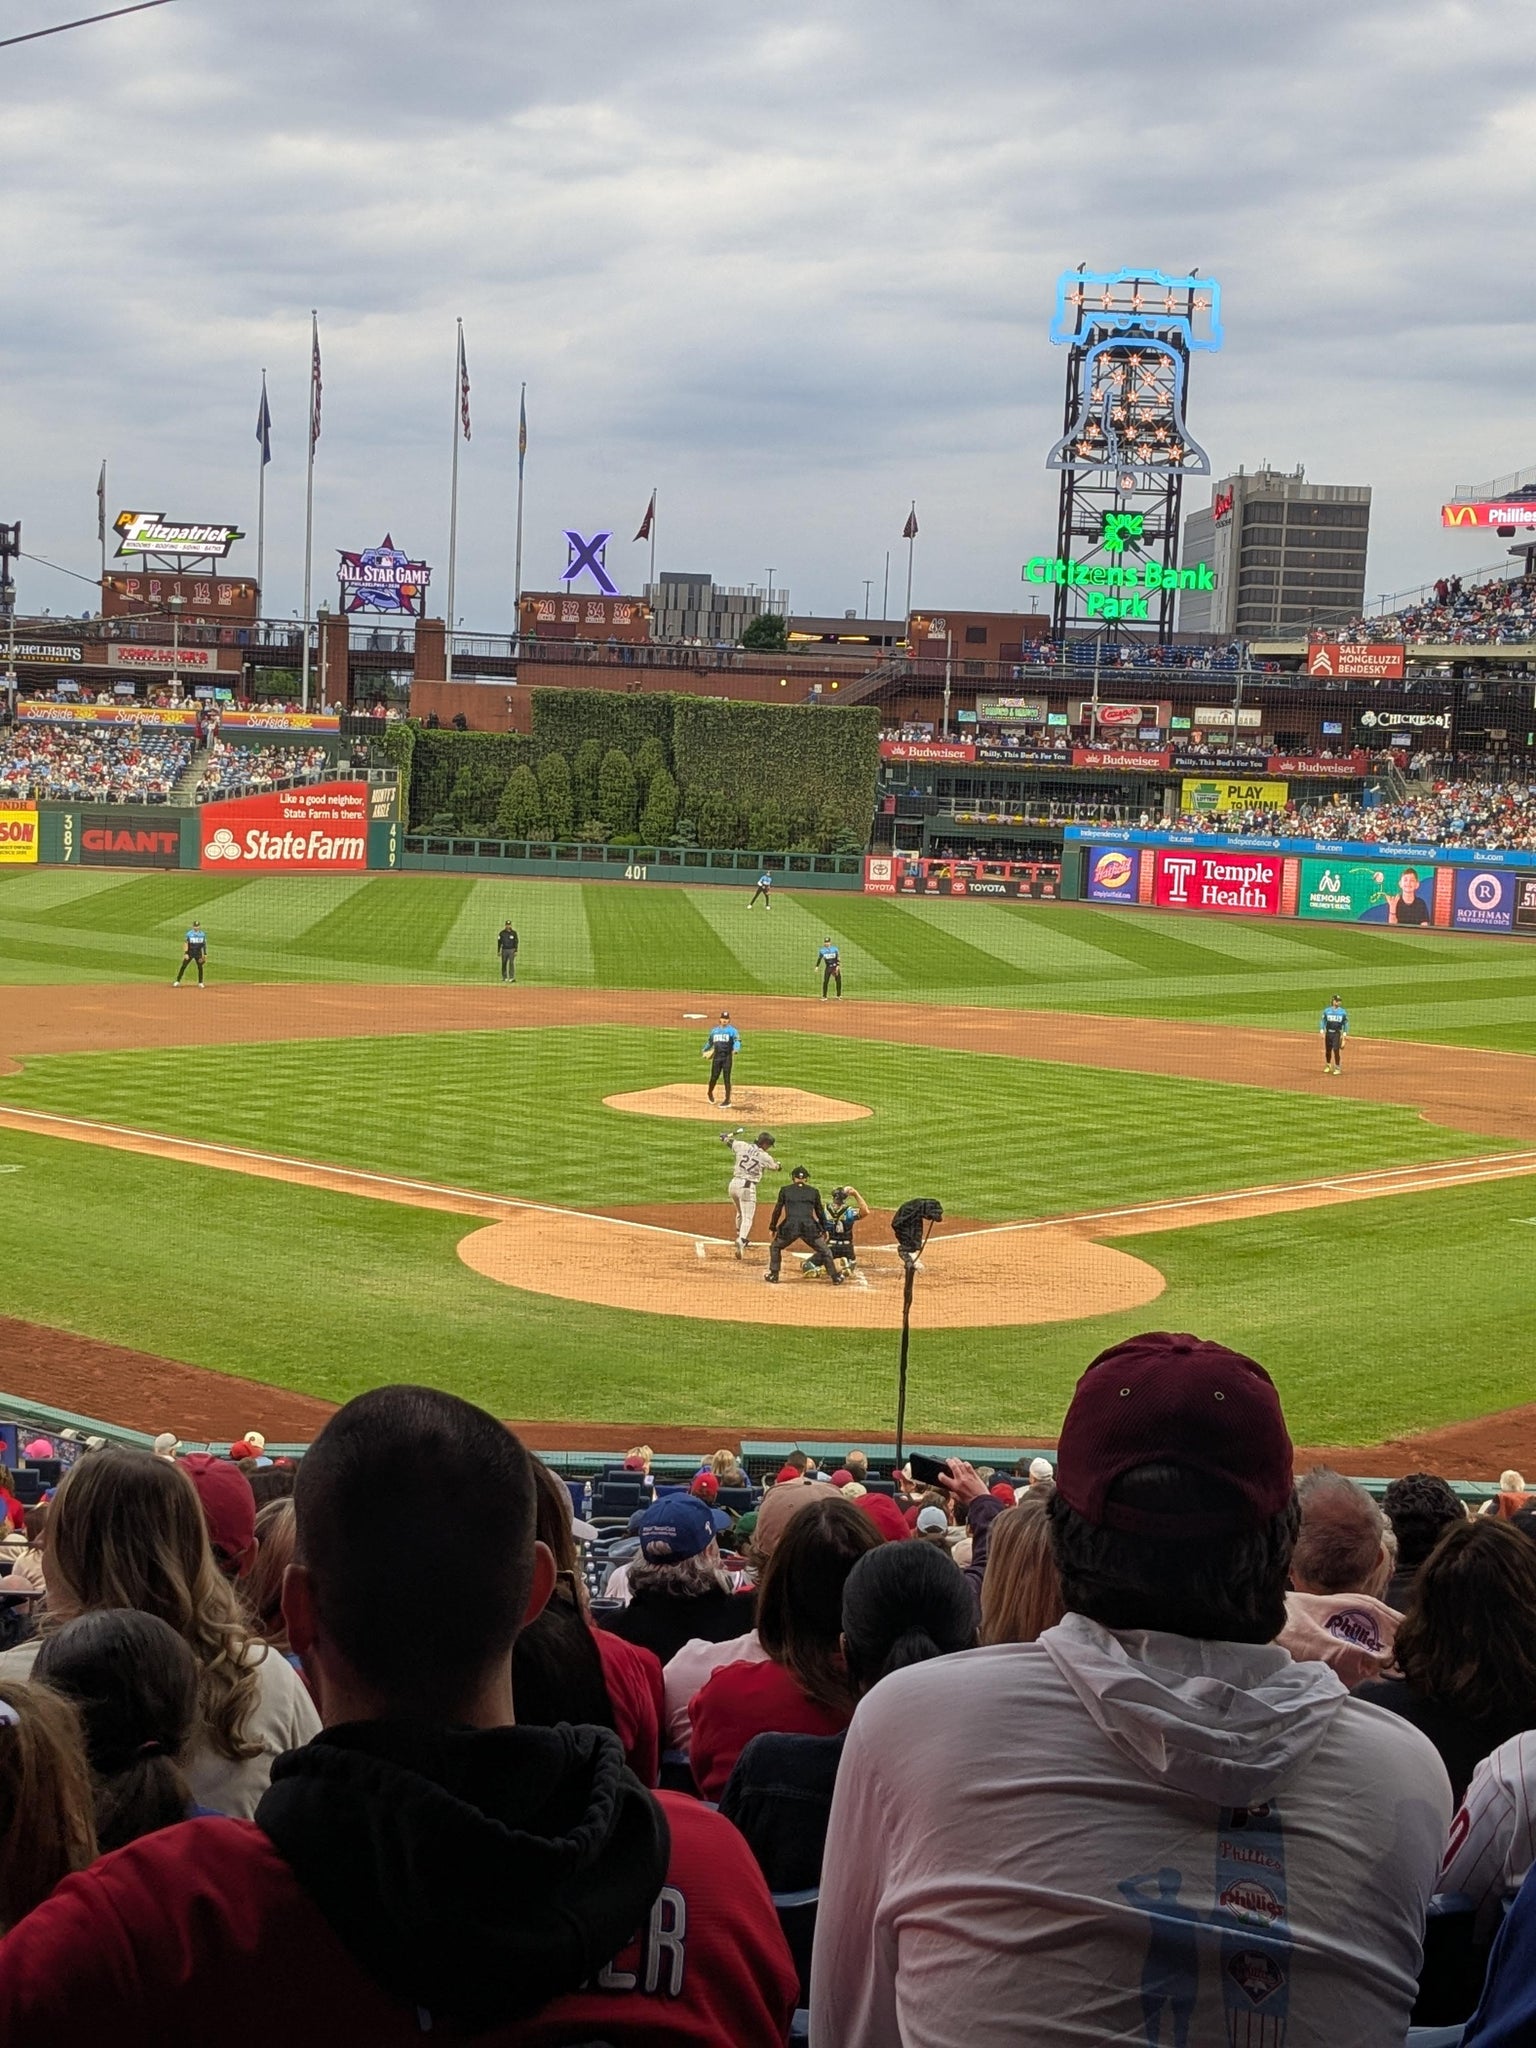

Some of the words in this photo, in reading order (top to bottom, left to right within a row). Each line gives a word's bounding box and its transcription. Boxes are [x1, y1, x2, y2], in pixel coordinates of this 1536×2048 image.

[117, 513, 139, 526] PJ
[124, 514, 230, 542] Fitzpatrick
[560, 530, 619, 595] X
[338, 563, 363, 581] ALL
[364, 565, 394, 583] STAR
[395, 567, 429, 585] GAME
[1026, 557, 1138, 587] Citizens
[1144, 561, 1214, 590] Bank
[194, 583, 210, 598] 14
[218, 584, 232, 598] 15
[538, 600, 555, 616] 20
[562, 601, 579, 617] 32
[588, 602, 604, 618] 34
[614, 603, 631, 619] 36
[1088, 593, 1148, 619] Park
[928, 618, 946, 634] 42
[1339, 645, 1368, 655] SALTZ
[1339, 655, 1401, 665] MONGELUZZI
[1338, 664, 1387, 674] BENDESKY
[28, 706, 73, 720] Surfside
[115, 708, 160, 723] Surfside
[1378, 712, 1435, 726] CHICKIE'S
[247, 713, 289, 728] Surfside
[908, 747, 965, 759] Budweiser
[1004, 750, 1019, 759] This
[1040, 752, 1052, 760] For
[1053, 752, 1066, 761] You
[1102, 754, 1159, 767] Budweiser
[1200, 759, 1214, 767] This
[1250, 760, 1263, 768] You
[1297, 761, 1356, 774] Budweiser
[1228, 785, 1263, 799] PLAY
[280, 793, 297, 804] Like
[299, 796, 304, 804] a
[306, 794, 326, 806] good
[328, 794, 364, 807] neighbor,
[1231, 801, 1243, 810] TO
[284, 808, 306, 818] State
[308, 809, 330, 819] Farm
[332, 810, 339, 819] is
[64, 814, 73, 862] 387
[81, 829, 178, 854] GIANT
[1080, 830, 1122, 840] Independence
[1168, 835, 1195, 844] ibx.com
[1227, 837, 1273, 847] Independence
[389, 823, 397, 867] 409
[1315, 843, 1343, 852] ibx.com
[1379, 846, 1427, 857] Independence
[1473, 852, 1504, 862] ibx.com
[625, 865, 647, 880] 401
[1202, 859, 1273, 887] Temple
[864, 883, 896, 892] TOYOTA
[969, 883, 1006, 893] TOYOTA
[1479, 885, 1492, 898] R
[1201, 884, 1267, 909] Health
[1310, 893, 1351, 904] NEMOURS
[1457, 909, 1511, 920] ROTHMAN
[739, 1155, 759, 1172] 27
[1324, 1614, 1385, 1651] Phillies
[1218, 1840, 1281, 1871] Phillies
[1219, 1889, 1284, 1918] Phillies
